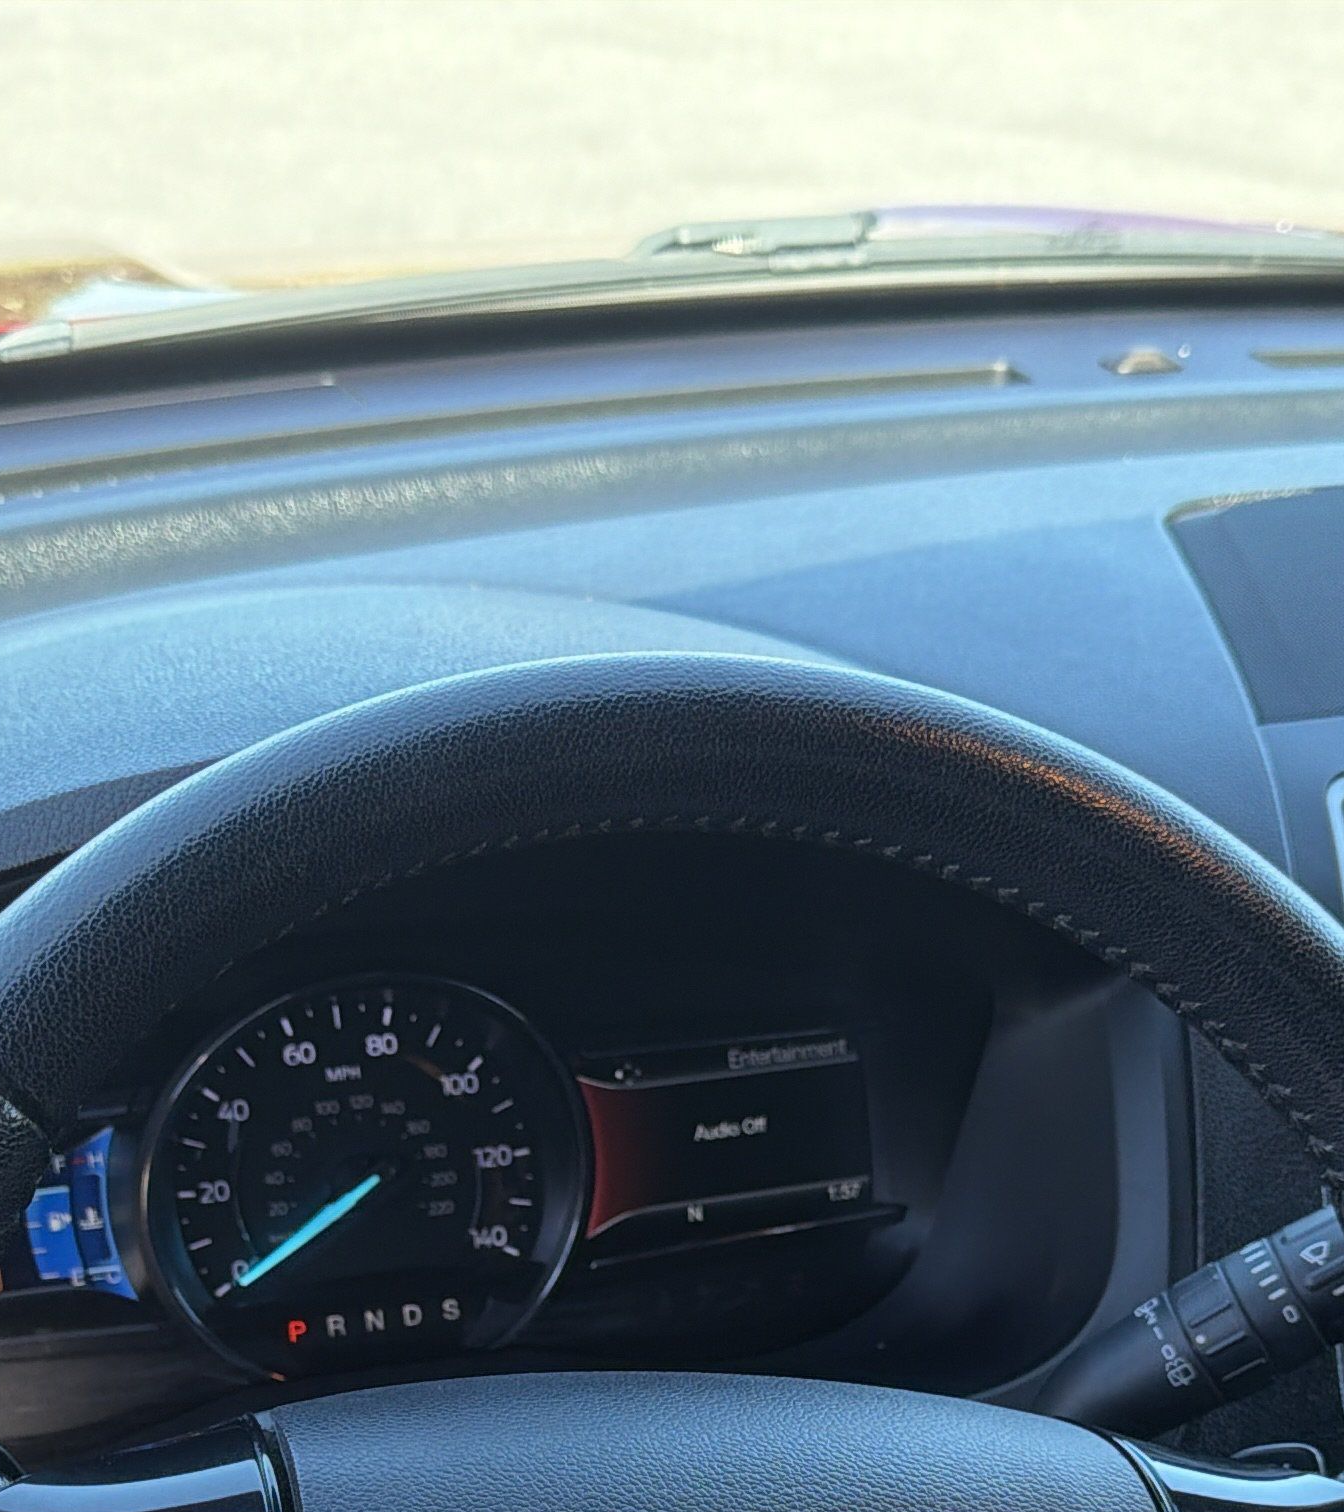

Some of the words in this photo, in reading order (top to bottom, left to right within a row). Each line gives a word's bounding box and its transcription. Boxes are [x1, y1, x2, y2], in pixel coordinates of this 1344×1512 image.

[283, 1041, 316, 1066] 60
[365, 1032, 398, 1057] 80
[325, 1065, 361, 1082] MPH
[440, 1073, 479, 1096] 100
[217, 1099, 250, 1122] 40
[694, 1120, 741, 1142] Audio
[473, 1145, 512, 1167] 120
[198, 1179, 230, 1203] 20
[469, 1225, 508, 1249] 140
[288, 1319, 307, 1343] P
[325, 1314, 346, 1337] R
[364, 1308, 385, 1332] N
[401, 1303, 422, 1327] D
[441, 1298, 461, 1322] S
